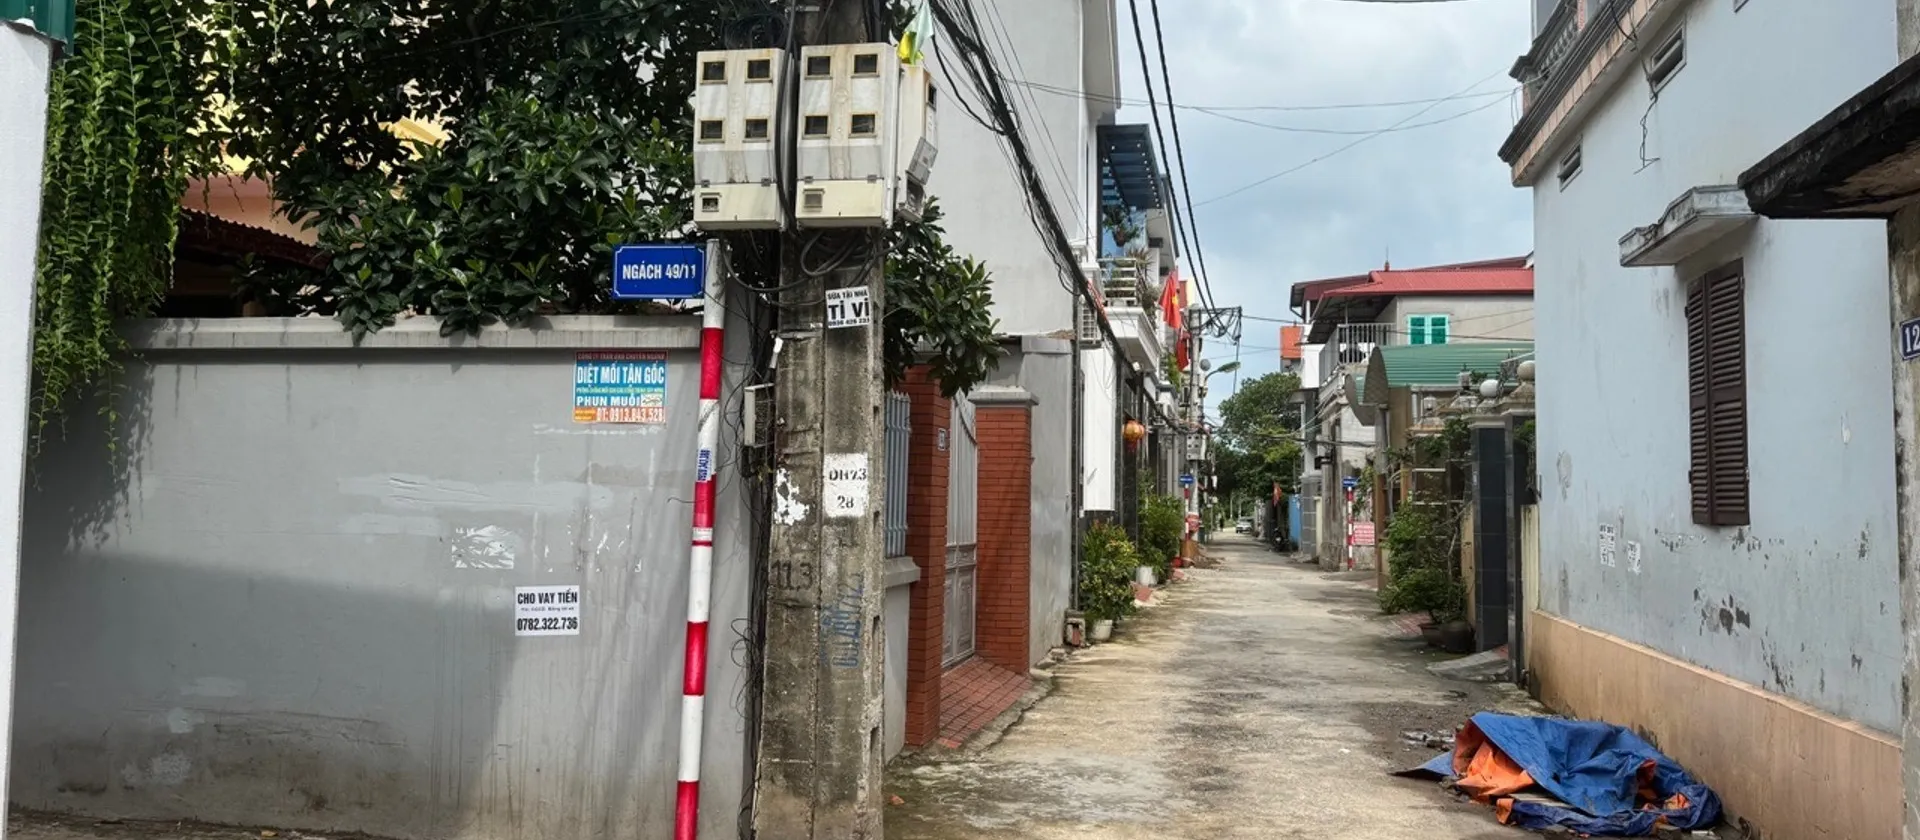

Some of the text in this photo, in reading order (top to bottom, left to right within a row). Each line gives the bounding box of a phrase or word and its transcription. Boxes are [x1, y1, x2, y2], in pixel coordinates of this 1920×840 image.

[622, 260, 697, 280] NGÁCH 49/11
[577, 363, 599, 388] DIỆT
[622, 363, 642, 388] TẬN
[644, 360, 665, 384] GỐC
[576, 396, 608, 407] PHUN
[517, 588, 578, 605] CHO VAY TIỀN
[517, 617, 578, 630] 0782.322.736
